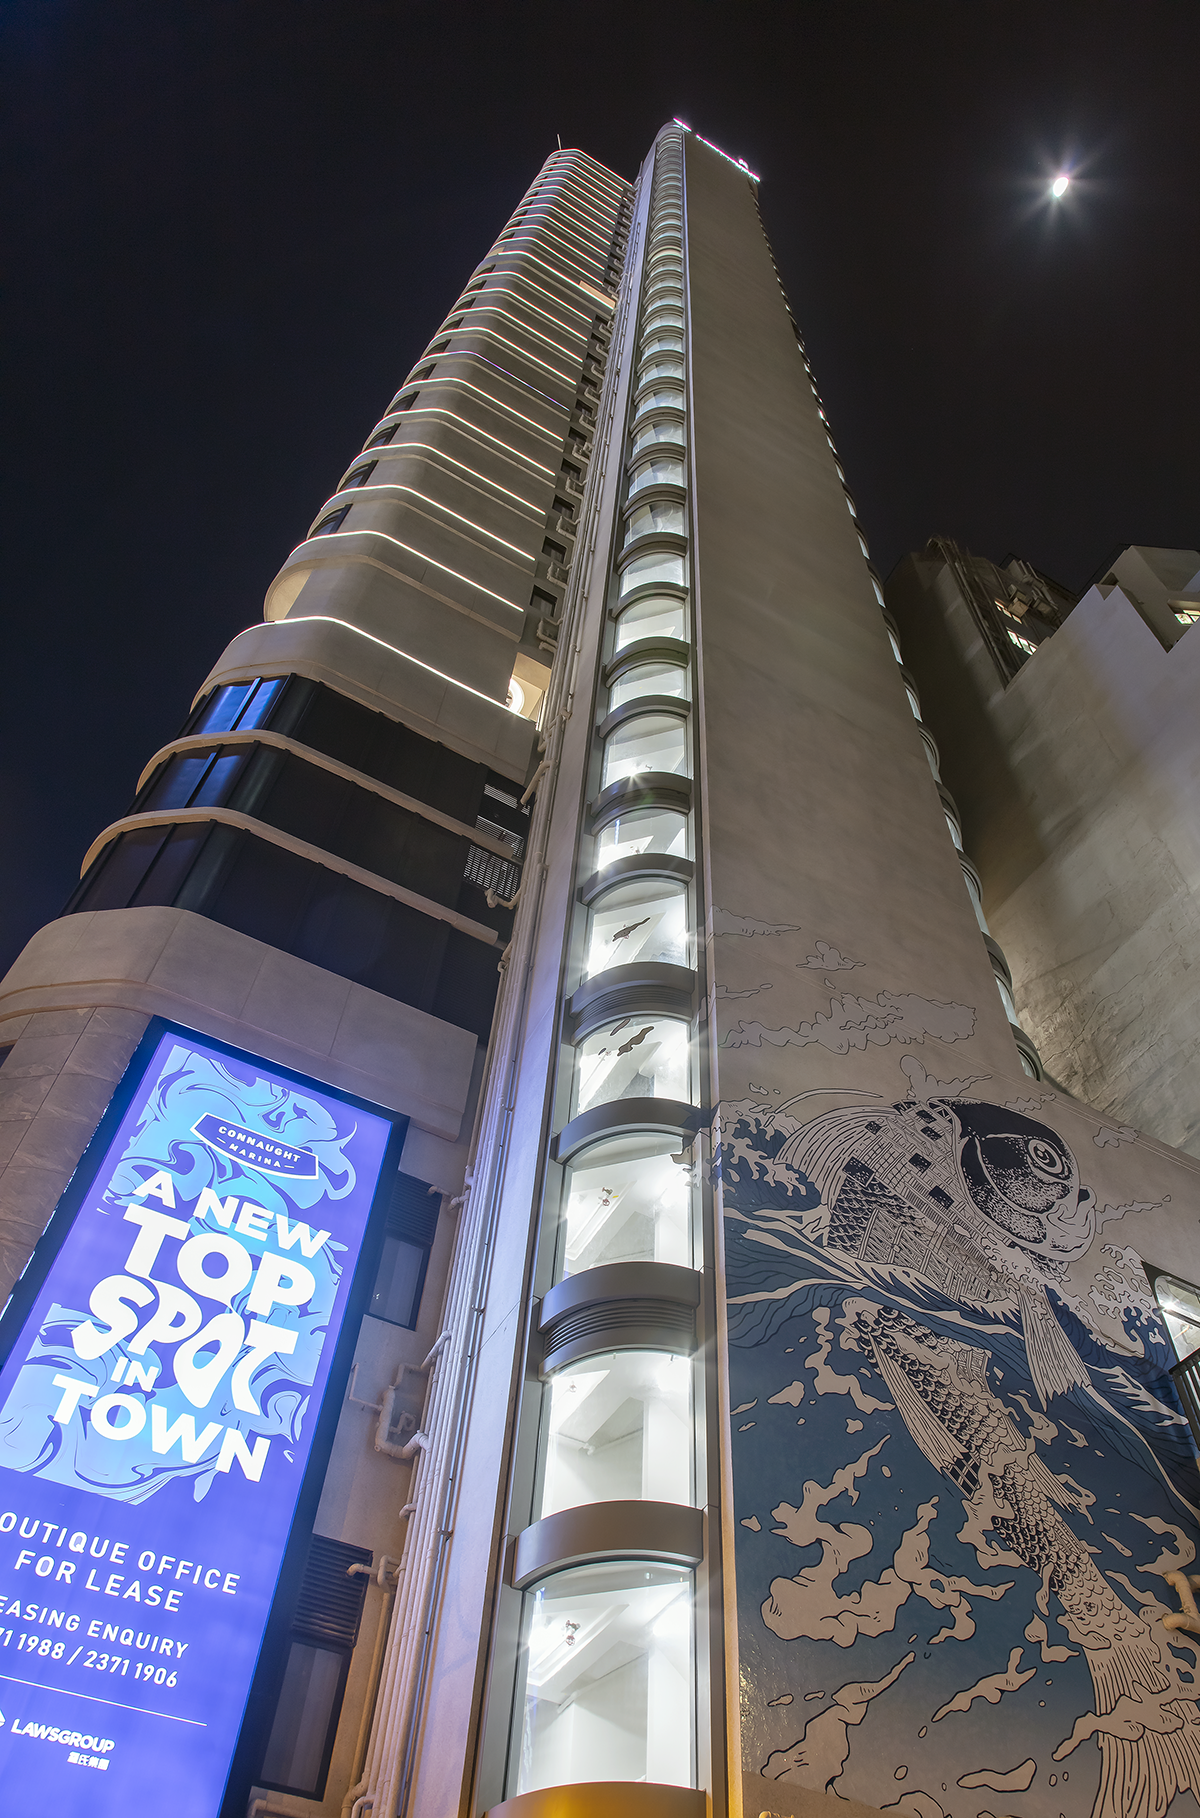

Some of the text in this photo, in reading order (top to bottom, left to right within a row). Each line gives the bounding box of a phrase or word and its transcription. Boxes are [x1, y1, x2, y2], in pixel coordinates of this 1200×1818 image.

[218, 1126, 301, 1163] CONNAUGHT
[228, 1143, 281, 1168] MARINA
[132, 1170, 331, 1259] A NEW
[123, 1203, 316, 1317] TOP
[71, 1274, 299, 1416] SPOT
[110, 1355, 160, 1393] IN
[51, 1373, 271, 1483] TOWN
[14, 1549, 184, 1613] FOR LEASE
[137, 1550, 241, 1595] OFFICE
[17, 1633, 66, 1660] 1988
[83, 1650, 131, 1677] 2371
[134, 1662, 178, 1688] 1906
[86, 1619, 189, 1659] ENQUIRY
[10, 1718, 115, 1754] LAWSGROUP
